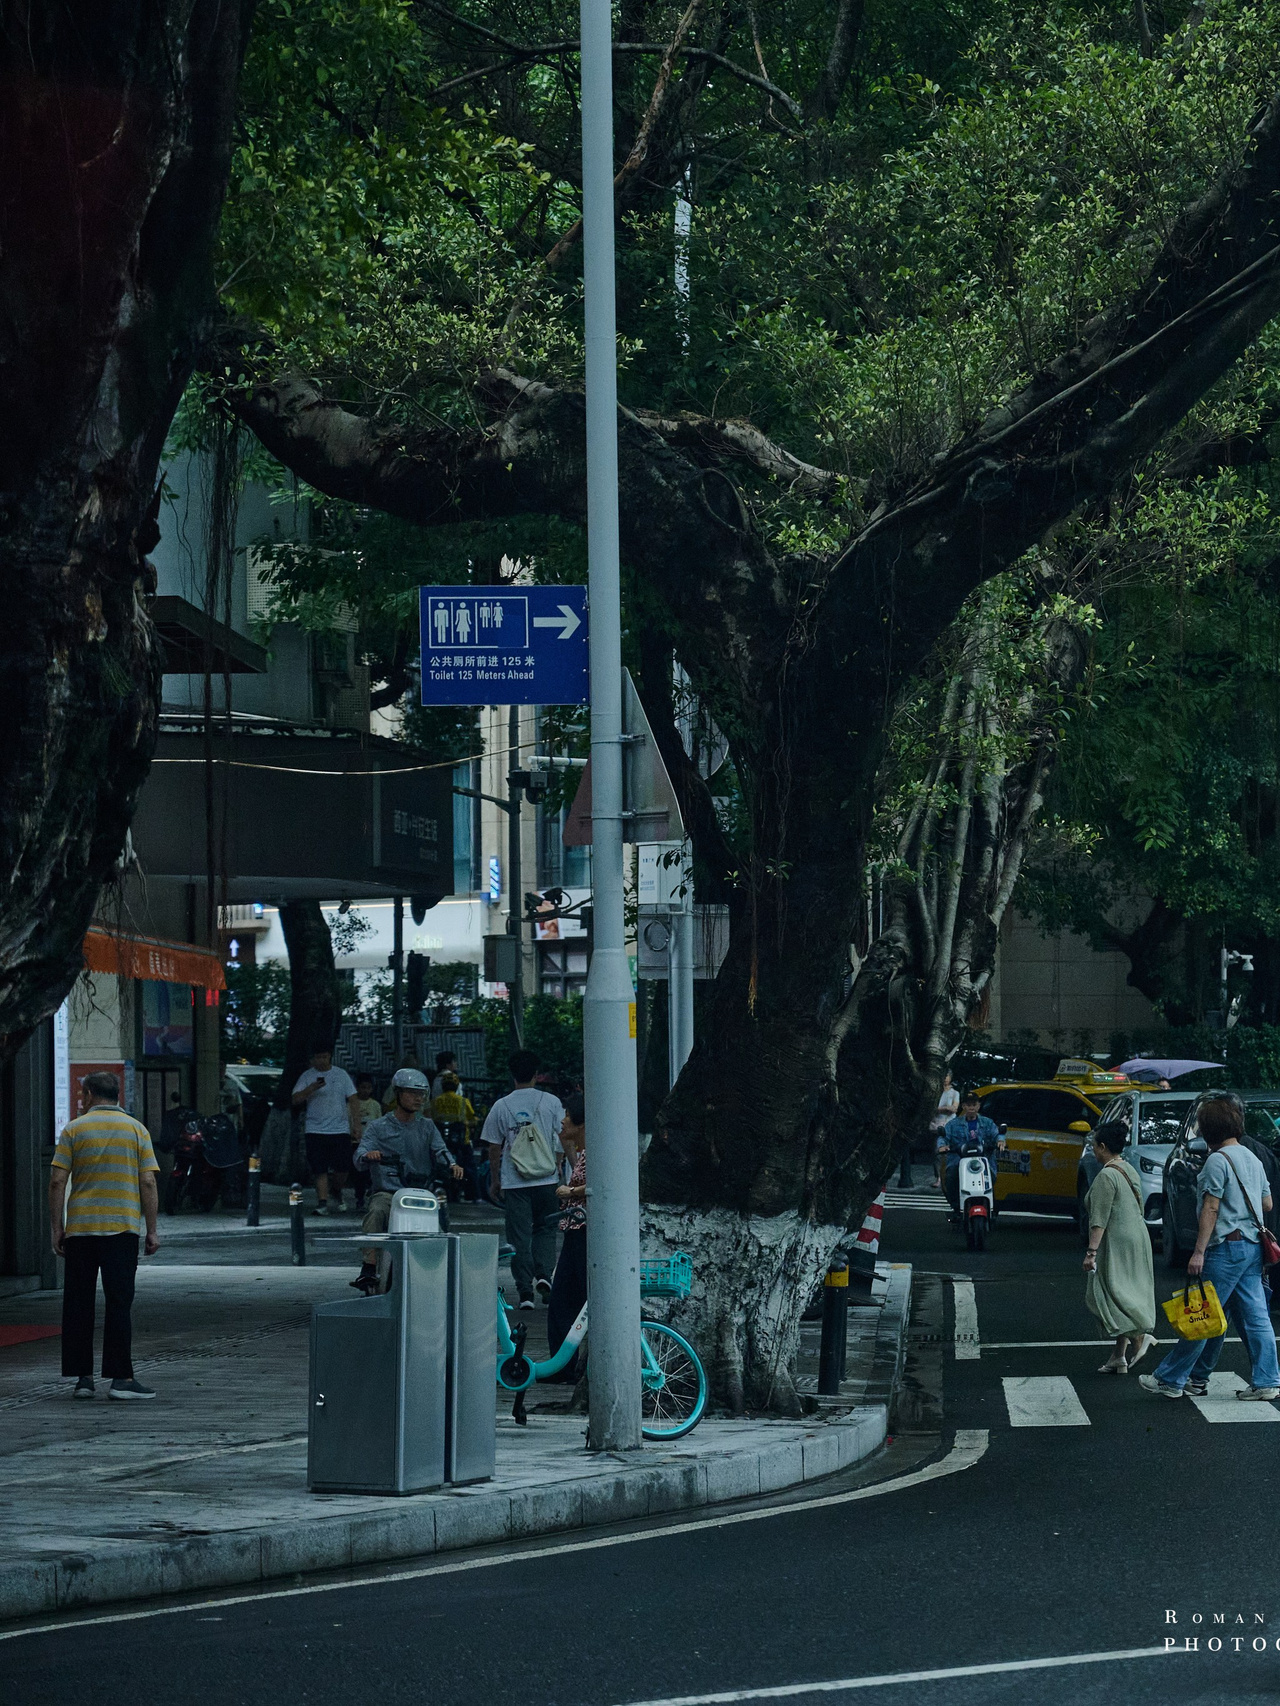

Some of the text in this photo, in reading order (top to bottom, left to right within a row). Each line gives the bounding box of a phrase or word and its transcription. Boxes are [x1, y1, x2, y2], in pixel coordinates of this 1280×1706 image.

[429, 655, 536, 668] 公共厕所前进 125 米
[429, 669, 534, 681] Toilet 125 Meters Ahead
[1188, 1310, 1210, 1324] Smile
